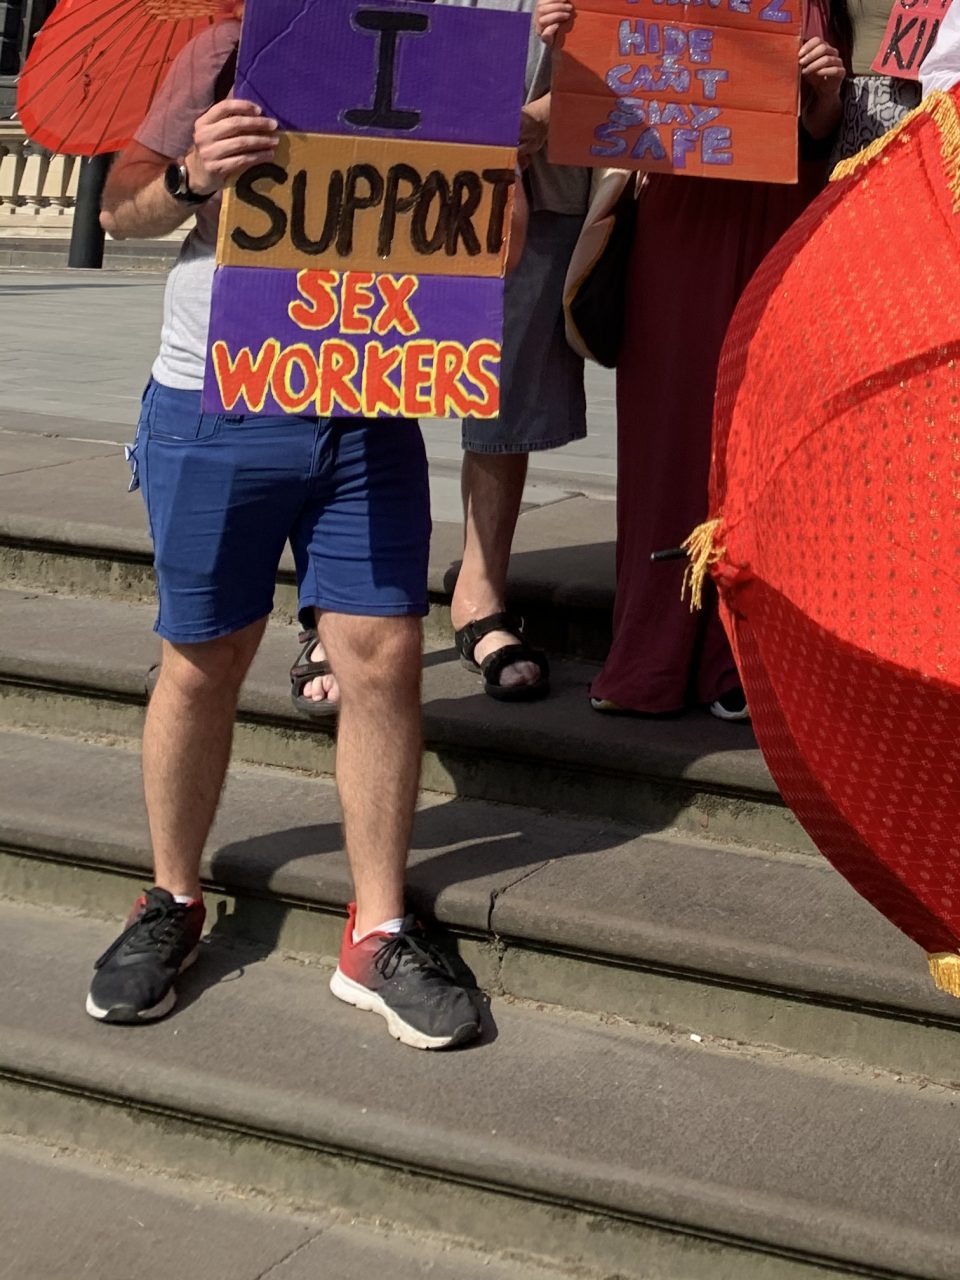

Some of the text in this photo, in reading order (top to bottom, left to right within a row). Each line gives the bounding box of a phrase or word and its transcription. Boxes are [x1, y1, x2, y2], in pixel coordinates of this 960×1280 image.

[343, 10, 430, 128] I
[618, 19, 713, 64] HIDE
[591, 122, 734, 169] SAFE
[230, 162, 516, 257] SUPPORT
[288, 268, 420, 335] SEX
[212, 337, 501, 418] WORKERS
